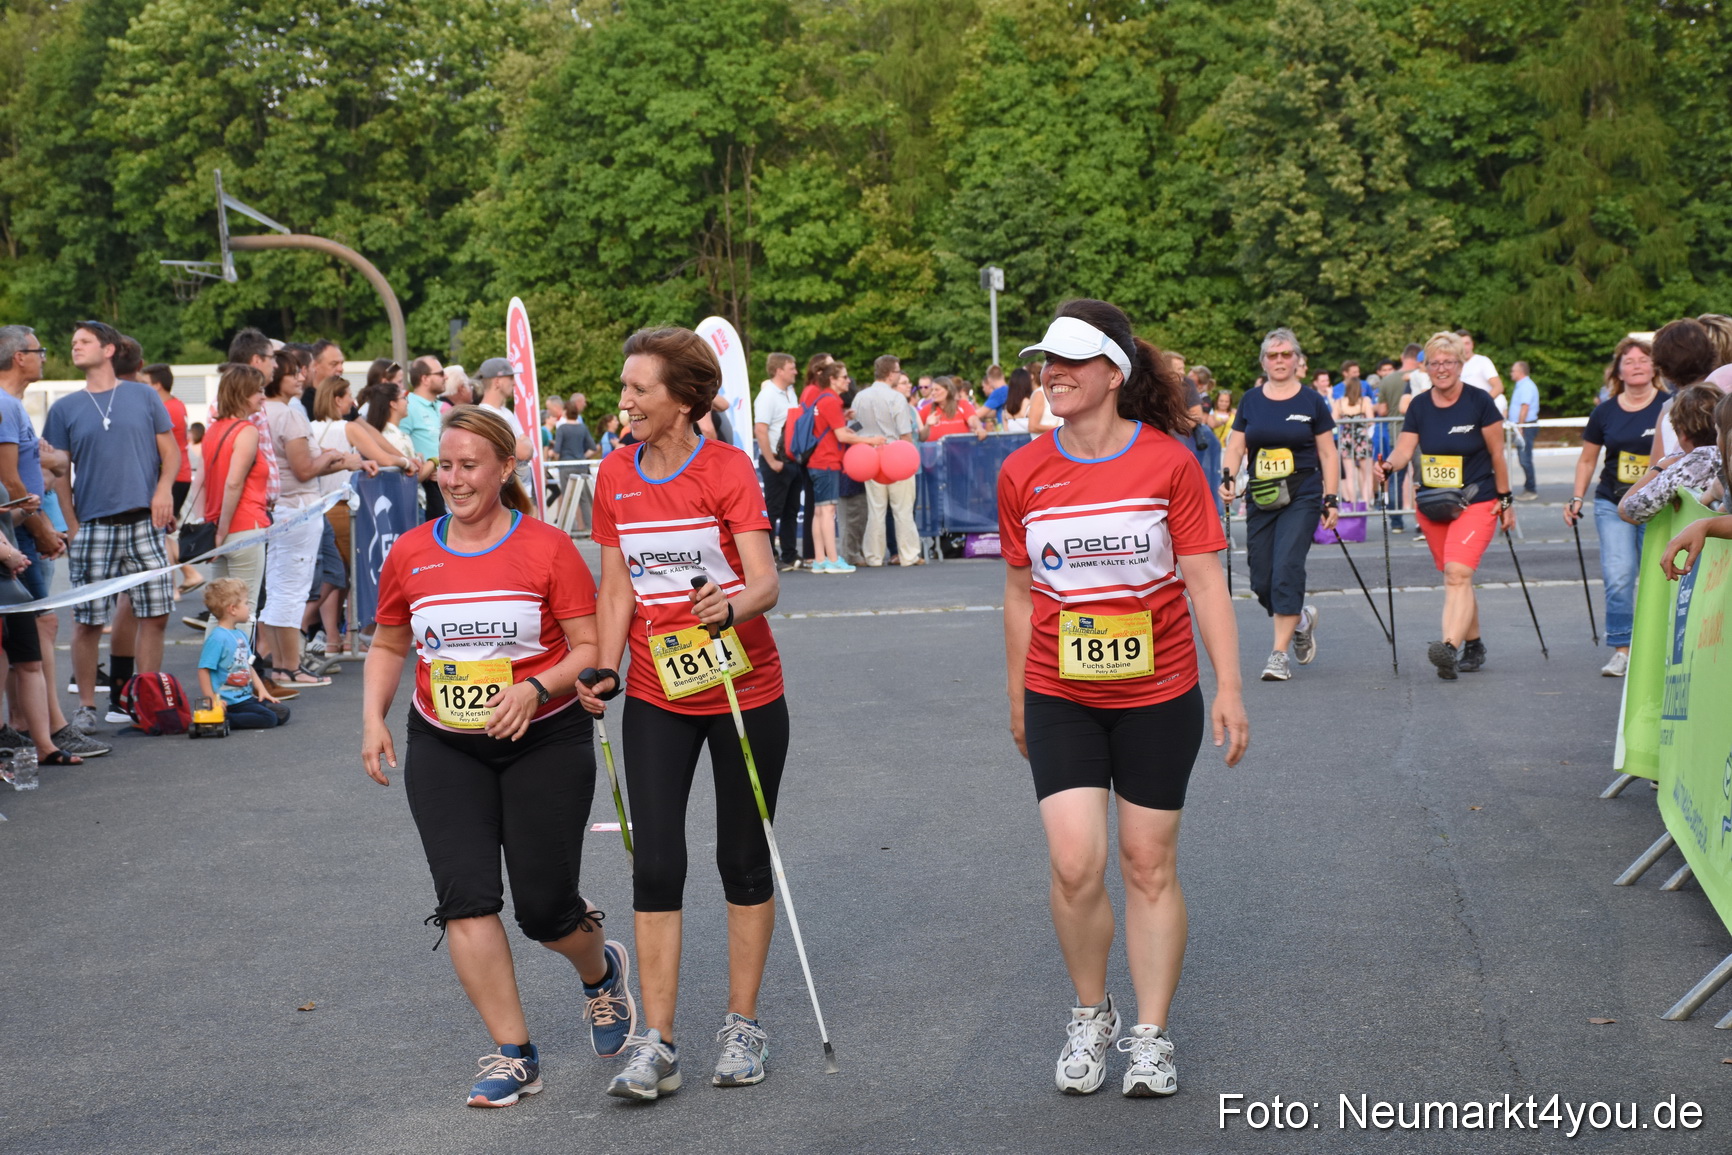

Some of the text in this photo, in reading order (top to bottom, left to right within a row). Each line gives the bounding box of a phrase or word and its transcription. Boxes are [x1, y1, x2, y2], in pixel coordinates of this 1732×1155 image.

[1260, 460, 1286, 471] 1411
[1426, 467, 1456, 478] 1386
[1064, 534, 1150, 554] Petry
[640, 550, 702, 565] Petry
[1069, 560, 1098, 568] WÄRME
[442, 622, 518, 638] Petry
[1071, 637, 1140, 662] 1819
[674, 672, 708, 688] Blendinger
[166, 696, 174, 707] FC
[450, 710, 464, 718] Krug
